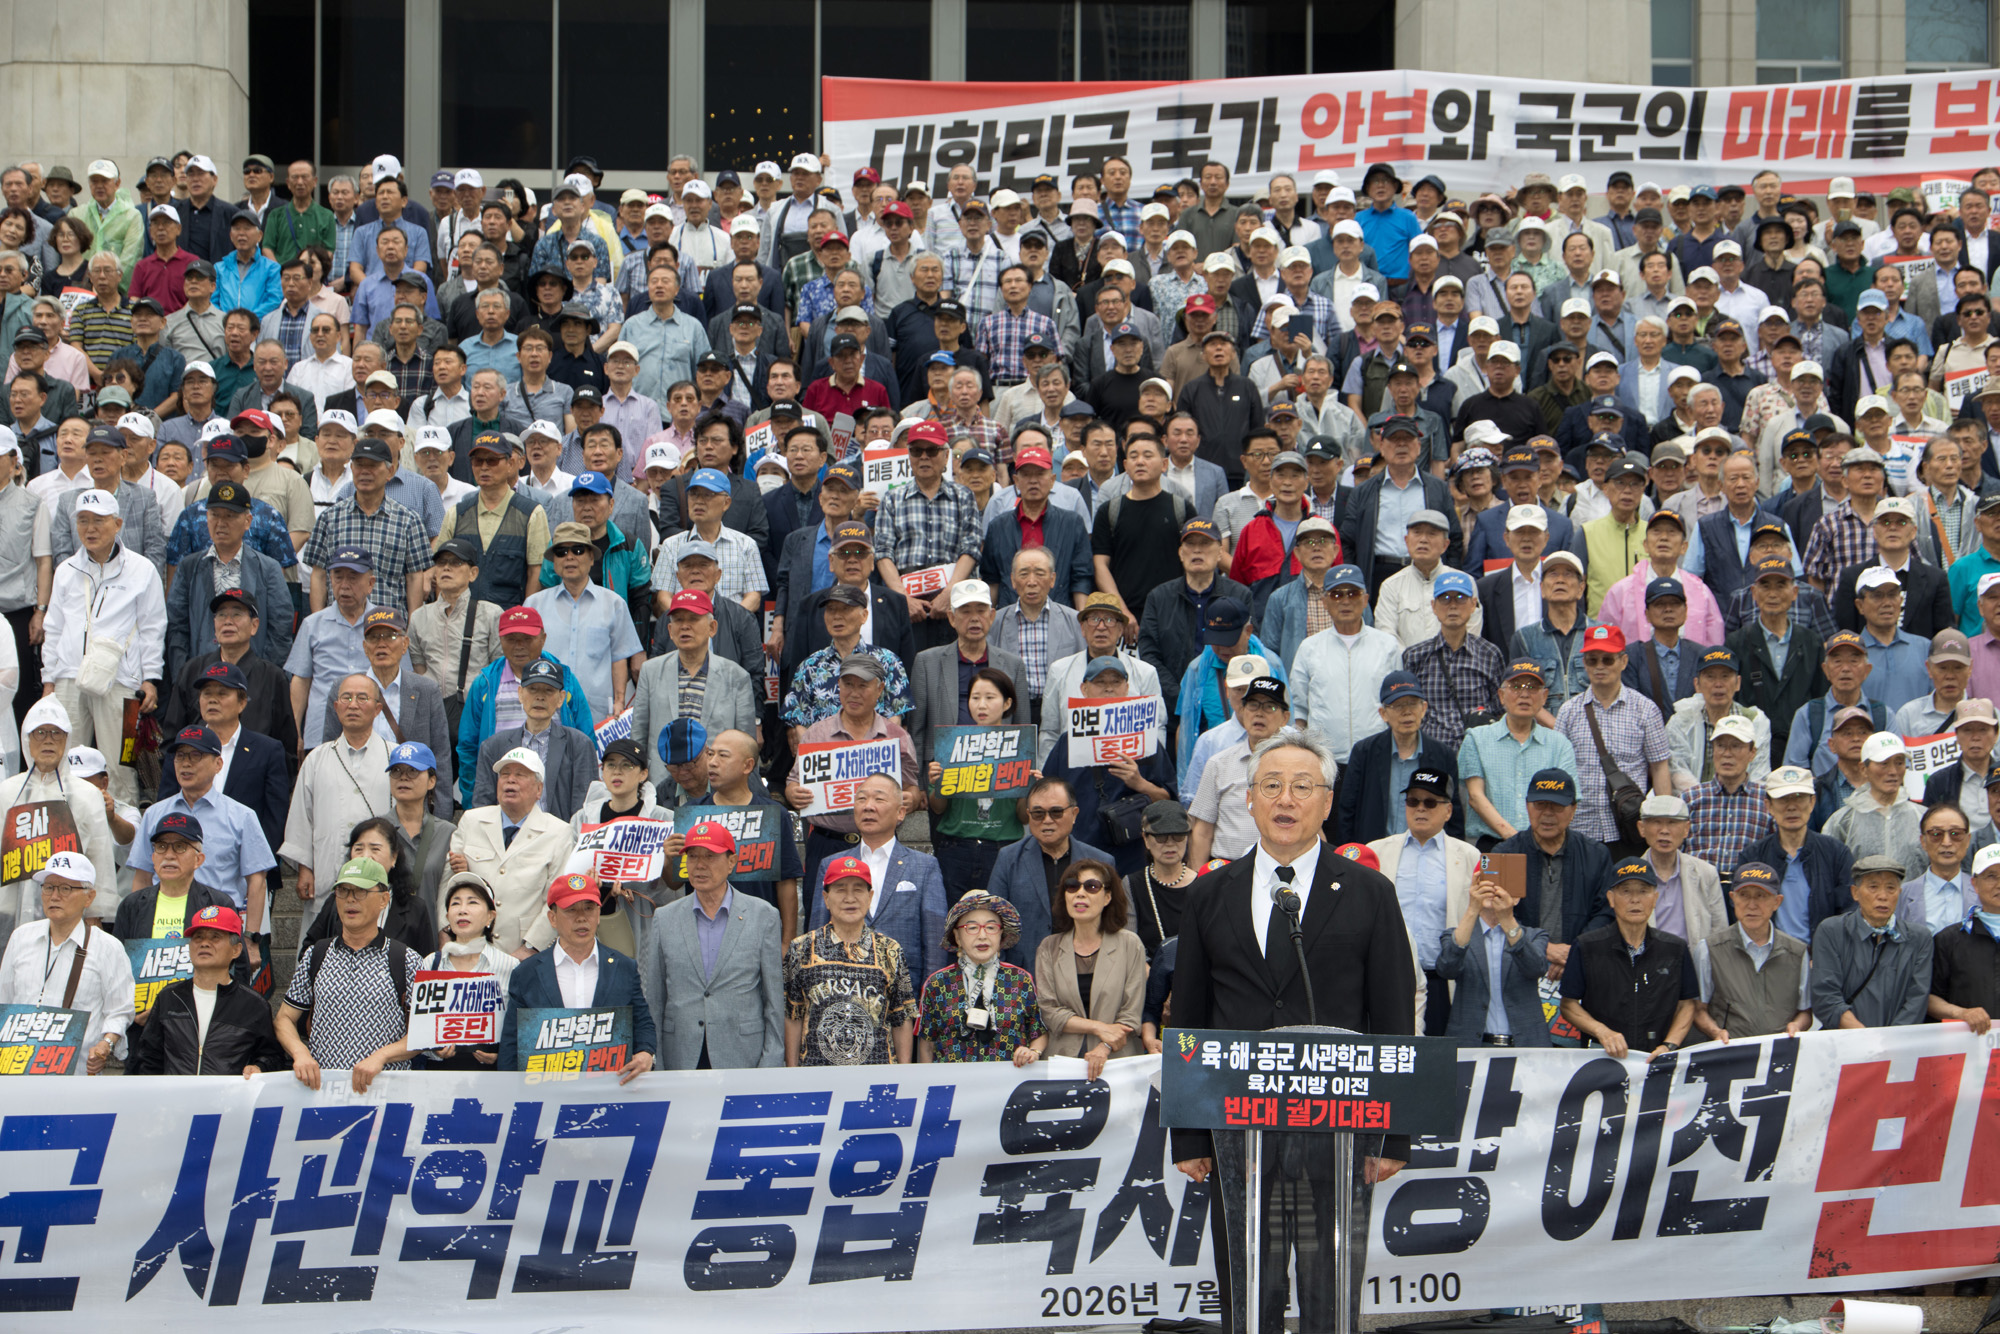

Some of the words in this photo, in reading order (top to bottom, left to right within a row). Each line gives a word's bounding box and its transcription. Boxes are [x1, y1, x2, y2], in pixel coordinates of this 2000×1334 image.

[870, 109, 1128, 199] 대한민국
[1151, 97, 1279, 173] 국가
[1298, 88, 1494, 171] 안보와
[1515, 89, 1707, 162] 국군의
[1721, 83, 1911, 161] 미래를
[1950, 379, 1970, 397] 태릉
[123, 416, 139, 424] NA
[330, 411, 346, 421] NA
[206, 423, 221, 432] NA
[424, 430, 439, 439] NA
[475, 432, 500, 445] KMA
[749, 428, 768, 453] 안보
[651, 448, 667, 458] NA
[1357, 457, 1373, 465] KM
[1507, 453, 1532, 463] KMA
[829, 468, 854, 478] KMA
[868, 461, 893, 482] 태릉
[83, 494, 99, 504] NA
[839, 529, 865, 538] KMA
[1186, 521, 1212, 531] KMA
[1759, 560, 1786, 571] KMA
[367, 612, 394, 624] KMA
[1833, 634, 1860, 643] KMA
[1703, 651, 1731, 662] KMA
[1511, 663, 1540, 673] KMA
[1254, 680, 1279, 691] KMA
[1072, 708, 1100, 737] 안보
[1103, 700, 1157, 735] 자해행위
[949, 729, 1020, 764] 사관학교
[1100, 736, 1140, 759] 중단
[803, 752, 831, 785] 안보
[835, 744, 896, 779] 자해행위
[940, 763, 993, 796] 통폐합
[994, 759, 1032, 790] 반대
[1415, 773, 1439, 783] KMA
[1536, 780, 1565, 790] KMA
[15, 806, 49, 840] 육사
[577, 827, 608, 852] 안보
[3, 847, 21, 883] 지방
[24, 838, 51, 873] 이전
[52, 857, 71, 868] NA
[600, 855, 645, 878] 중단
[736, 841, 776, 873] 반대
[1617, 864, 1646, 876] KMA
[1740, 868, 1773, 880] KMA
[414, 982, 448, 1015] 안보
[449, 980, 506, 1013] 자해행위
[0, 1012, 73, 1042] 사관학교
[442, 1016, 489, 1040] 중단
[535, 1012, 615, 1050] 사관학교
[1178, 1032, 1197, 1052] 졸속
[0, 1044, 35, 1075] 폐합
[29, 1045, 76, 1075] 반대
[524, 1049, 585, 1085] 통폐합
[586, 1044, 628, 1078] 반대
[1201, 1040, 1295, 1071] 육·해·공군
[1299, 1043, 1374, 1073] 사관학교
[1379, 1045, 1417, 1074] 통합
[1247, 1073, 1286, 1094] 육사
[1288, 1076, 1328, 1095] 지방
[1331, 1077, 1369, 1096] 이전
[1224, 1096, 1279, 1127] 반대
[1285, 1098, 1391, 1129] 궐기대회
[125, 1098, 671, 1306] 사관학교
[682, 1083, 961, 1292] 통합
[972, 1079, 1211, 1275] 육사
[1383, 1057, 1522, 1257] 방
[1540, 1037, 1799, 1241] 이전
[1040, 1279, 1159, 1318] 2026년
[1174, 1283, 1220, 1315] 7월
[1366, 1272, 1461, 1305] 11:00
